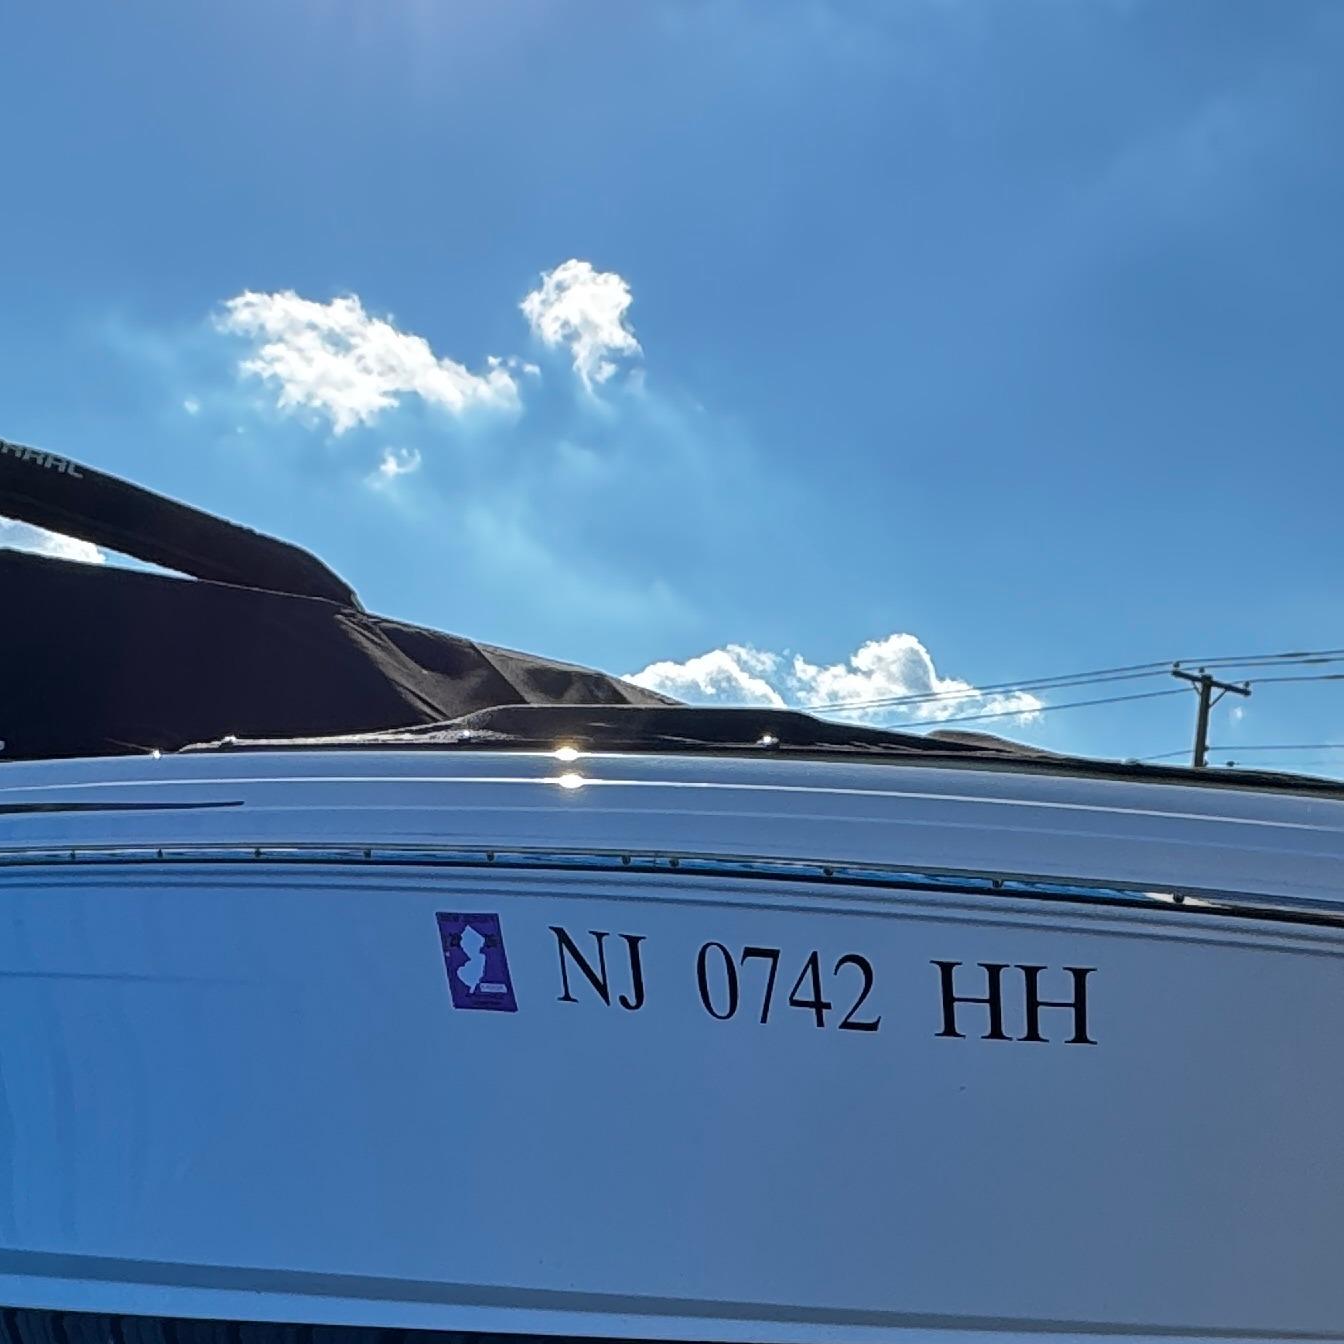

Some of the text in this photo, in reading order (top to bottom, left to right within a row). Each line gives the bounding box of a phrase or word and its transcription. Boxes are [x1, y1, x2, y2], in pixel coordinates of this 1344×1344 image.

[548, 926, 1098, 1046] NJ 0742 HH
